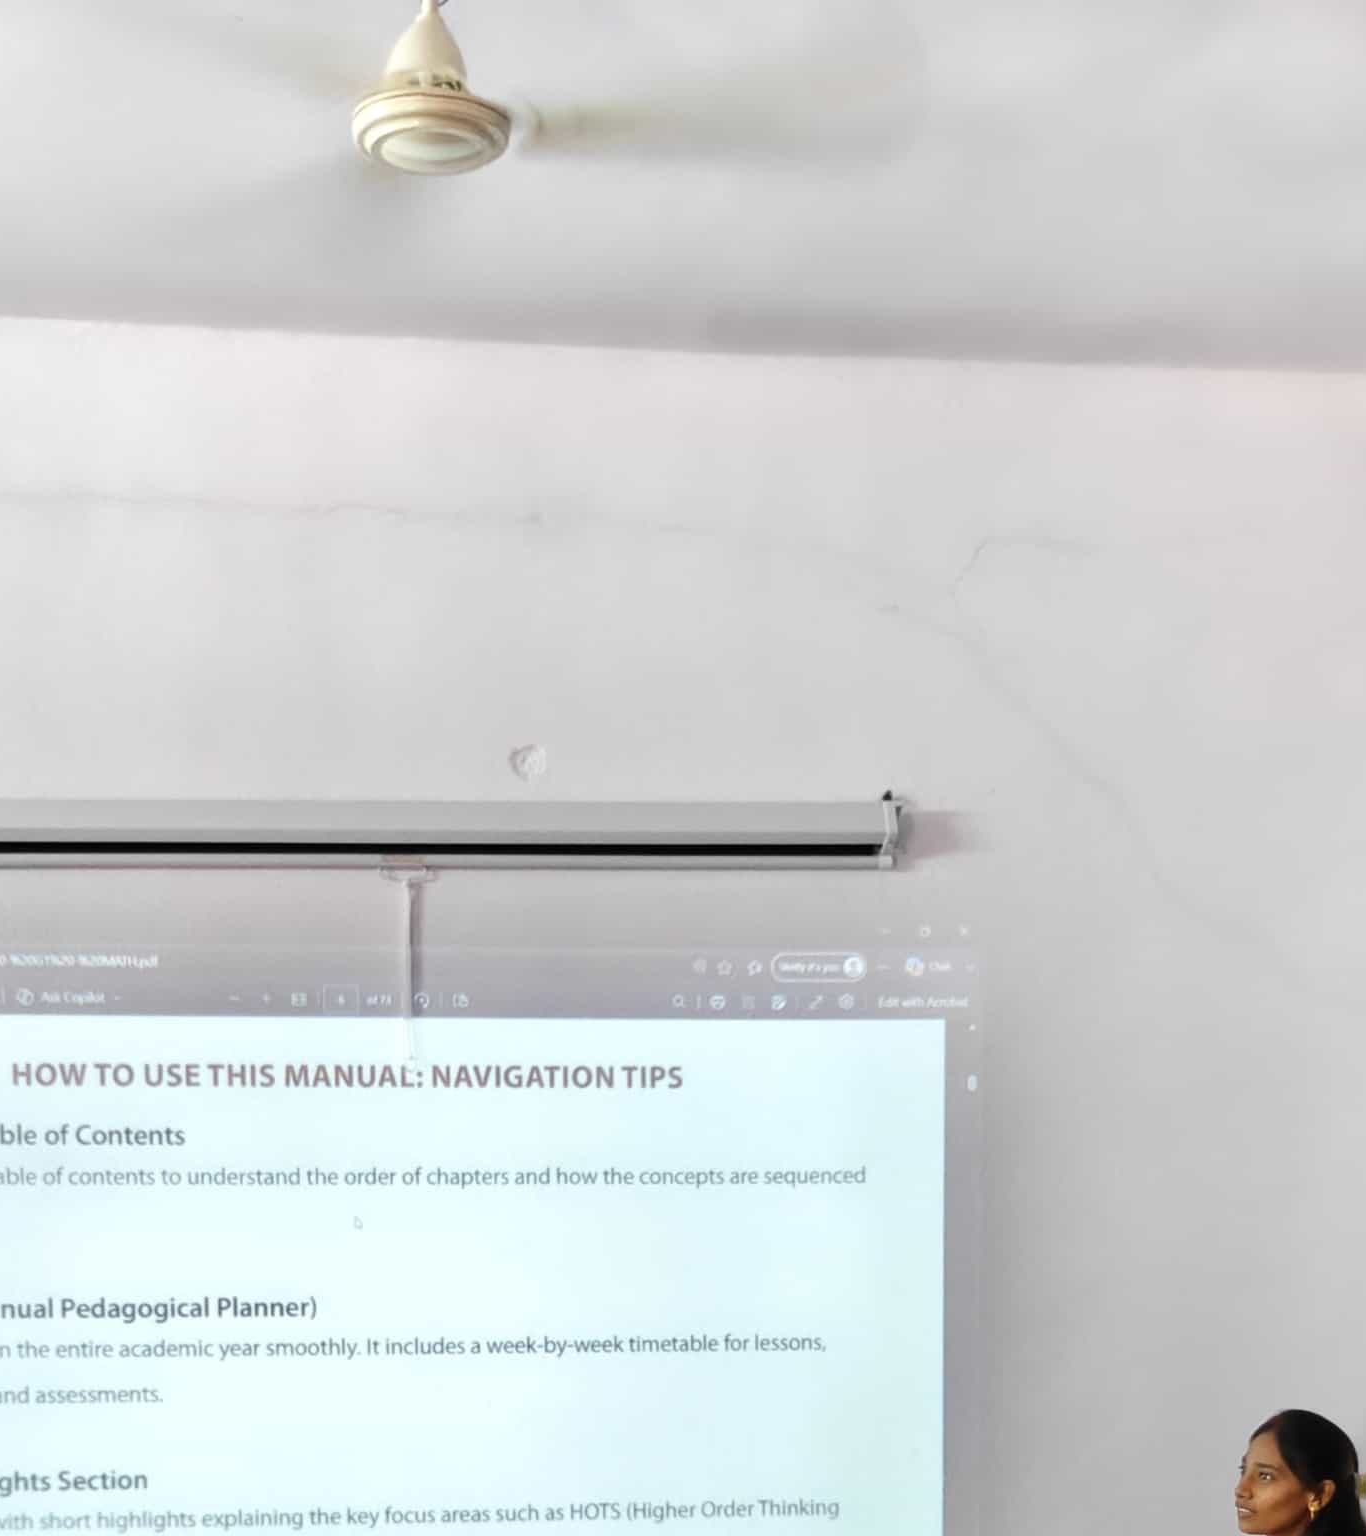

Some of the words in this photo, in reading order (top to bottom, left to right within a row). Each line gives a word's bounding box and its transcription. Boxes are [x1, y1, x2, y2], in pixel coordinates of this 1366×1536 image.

[11, 1062, 88, 1087] HOW
[93, 1062, 135, 1088] TO
[143, 1063, 201, 1088] USE
[206, 1063, 276, 1088] THIS
[284, 1063, 424, 1089] MANUAL:
[431, 1064, 615, 1089] NAVIGATION
[620, 1065, 683, 1090] TIPS
[44, 1123, 70, 1146] of
[74, 1123, 186, 1146] Contents
[42, 1165, 65, 1187] of
[67, 1168, 156, 1187] contents
[160, 1169, 182, 1186] to
[187, 1167, 301, 1186] understand
[306, 1167, 340, 1186] the
[343, 1166, 398, 1186] order
[401, 1165, 423, 1186] of
[426, 1167, 510, 1190] chapters
[514, 1165, 551, 1185] and
[555, 1166, 599, 1186] how
[602, 1166, 636, 1186] the
[638, 1169, 726, 1190] concepts
[728, 1170, 760, 1185] are
[763, 1164, 867, 1189] sequenced
[60, 1296, 210, 1325] Pedagogical
[217, 1295, 317, 1321] Planner)
[15, 1339, 51, 1360] the
[55, 1339, 114, 1359] entire
[118, 1338, 214, 1359] academic
[218, 1342, 261, 1361] year
[266, 1337, 361, 1361] smoothly.
[366, 1337, 380, 1356] It
[385, 1336, 466, 1356] includes
[470, 1340, 481, 1355] a
[486, 1335, 625, 1358] week-by-week
[628, 1333, 720, 1353] timetable
[723, 1332, 750, 1352] for
[754, 1333, 827, 1353] lessons,
[34, 1387, 164, 1405] assessments.
[57, 1470, 148, 1492] Section
[38, 1511, 92, 1531] short
[96, 1509, 197, 1535] highlights
[200, 1508, 304, 1532] explaining
[308, 1506, 342, 1526] the
[346, 1506, 380, 1529] key
[384, 1505, 436, 1525] focus
[440, 1508, 491, 1524] areas
[495, 1503, 540, 1523] such
[544, 1506, 565, 1522] as
[570, 1501, 622, 1521] HOTS
[626, 1500, 697, 1524] (Higher
[700, 1499, 755, 1519] Order
[757, 1497, 840, 1521] Thinking
